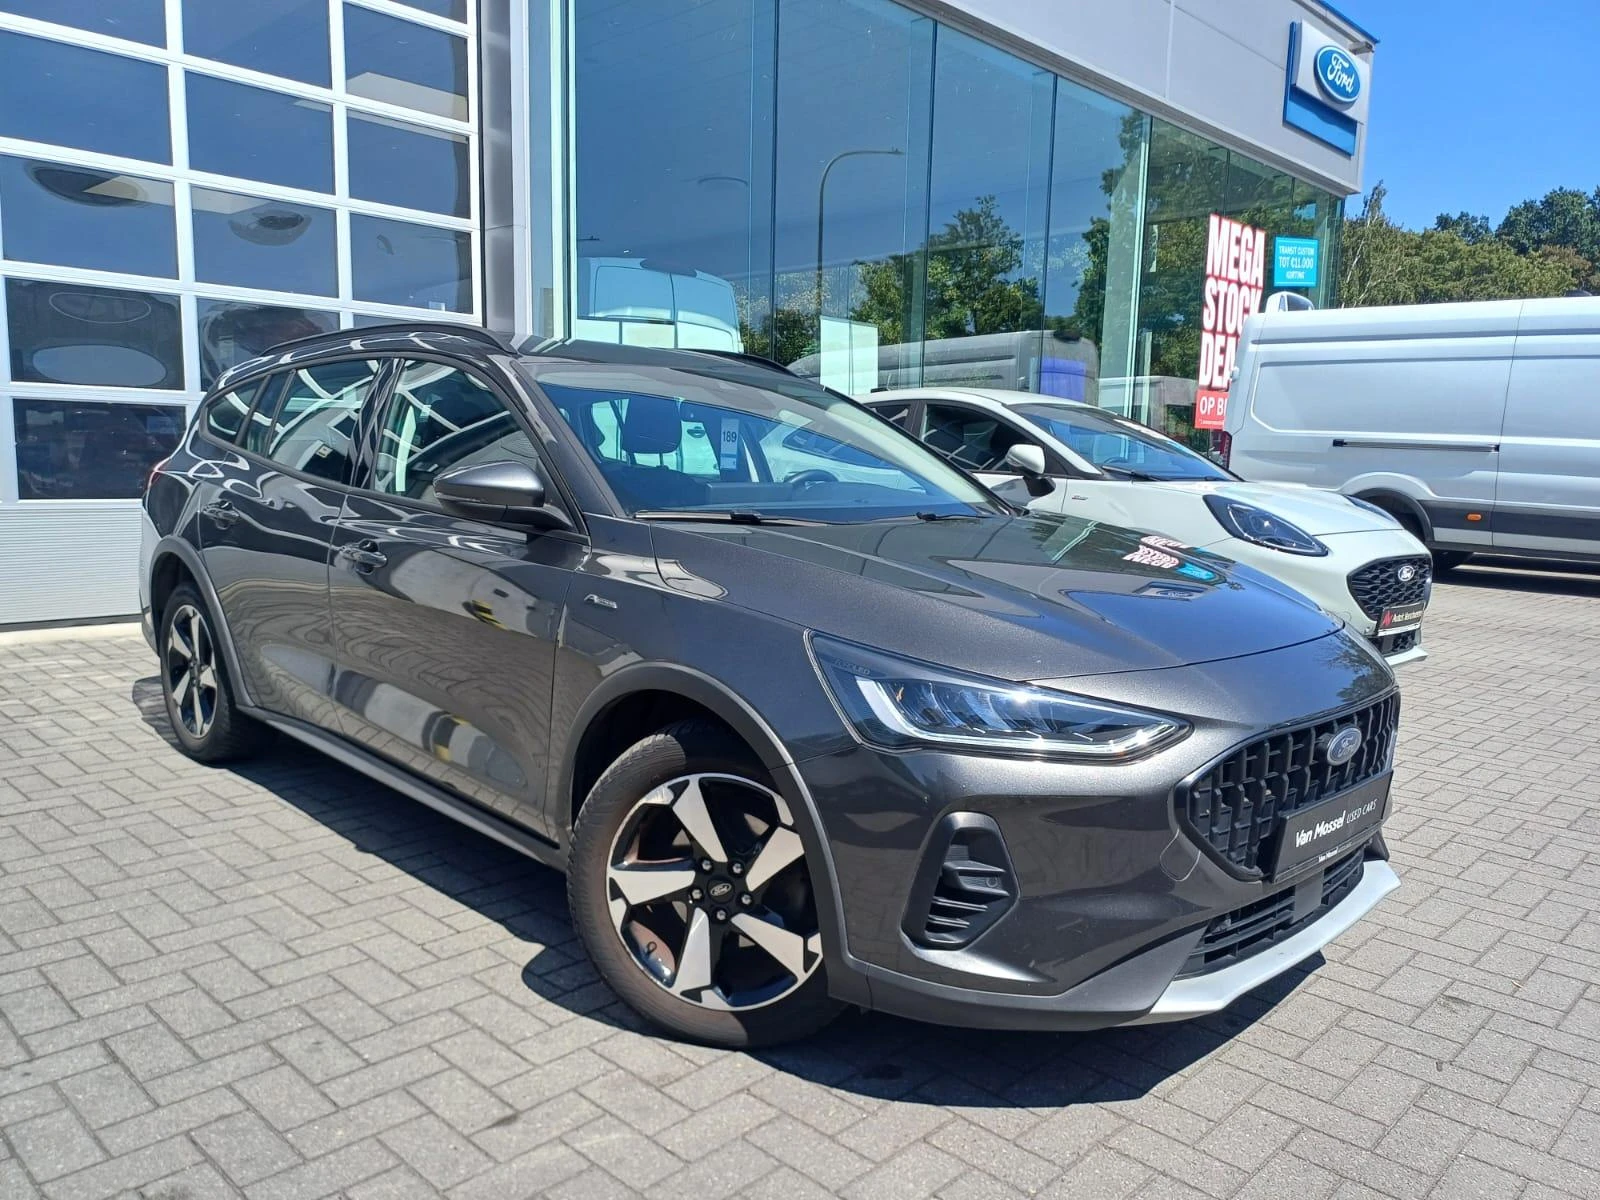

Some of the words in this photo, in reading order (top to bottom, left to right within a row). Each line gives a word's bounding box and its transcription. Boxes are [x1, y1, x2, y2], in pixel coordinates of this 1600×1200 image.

[1327, 53, 1355, 93] Ford
[1206, 213, 1266, 288] MEGA
[1279, 245, 1297, 255] TRANSIT
[1279, 256, 1290, 268] TOT
[1199, 331, 1236, 389] DEA
[1200, 396, 1215, 415] OP
[722, 430, 737, 443] 189
[1296, 829, 1313, 847] Van
[1313, 810, 1346, 840] Mossel
[1346, 807, 1361, 824] USED
[1362, 798, 1378, 815] CARS
